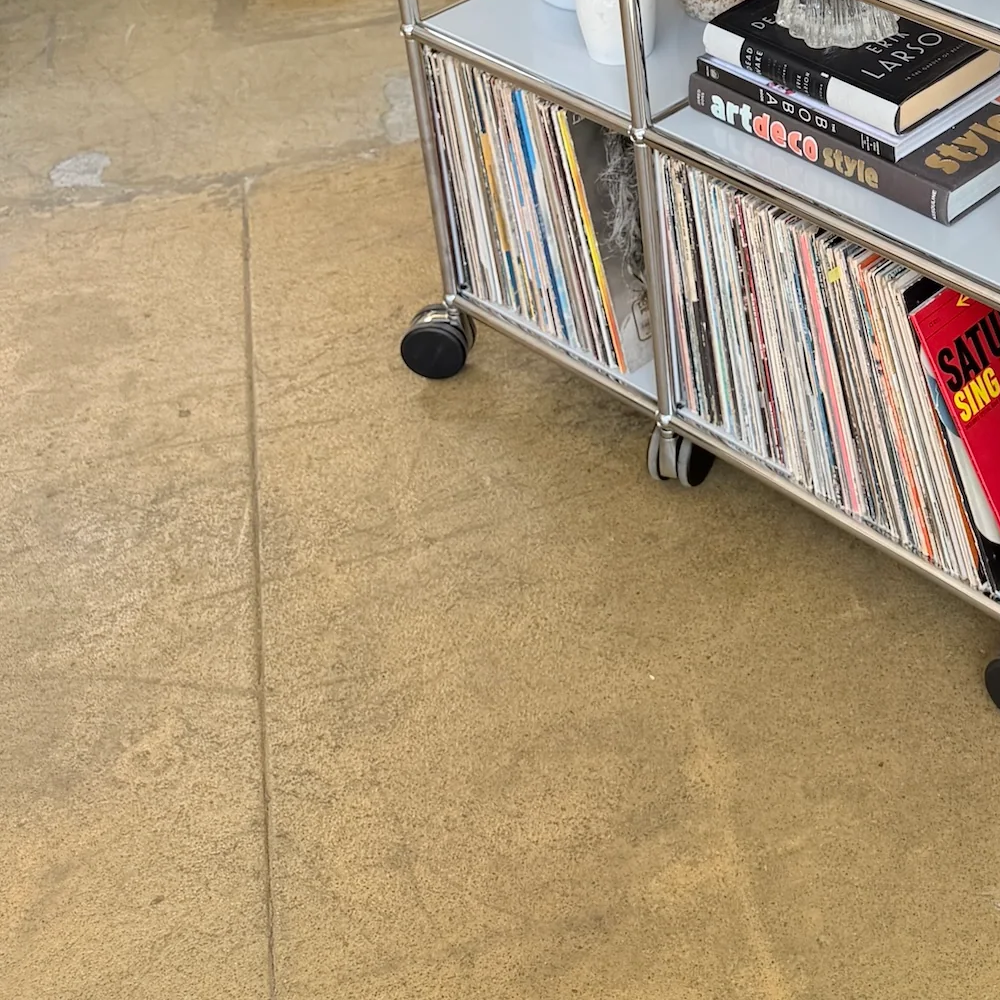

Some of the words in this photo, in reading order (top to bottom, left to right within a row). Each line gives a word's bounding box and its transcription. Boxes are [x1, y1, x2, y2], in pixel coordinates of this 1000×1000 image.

[861, 33, 943, 79] LARSO
[822, 147, 880, 189] style
[953, 367, 1000, 422] SING
